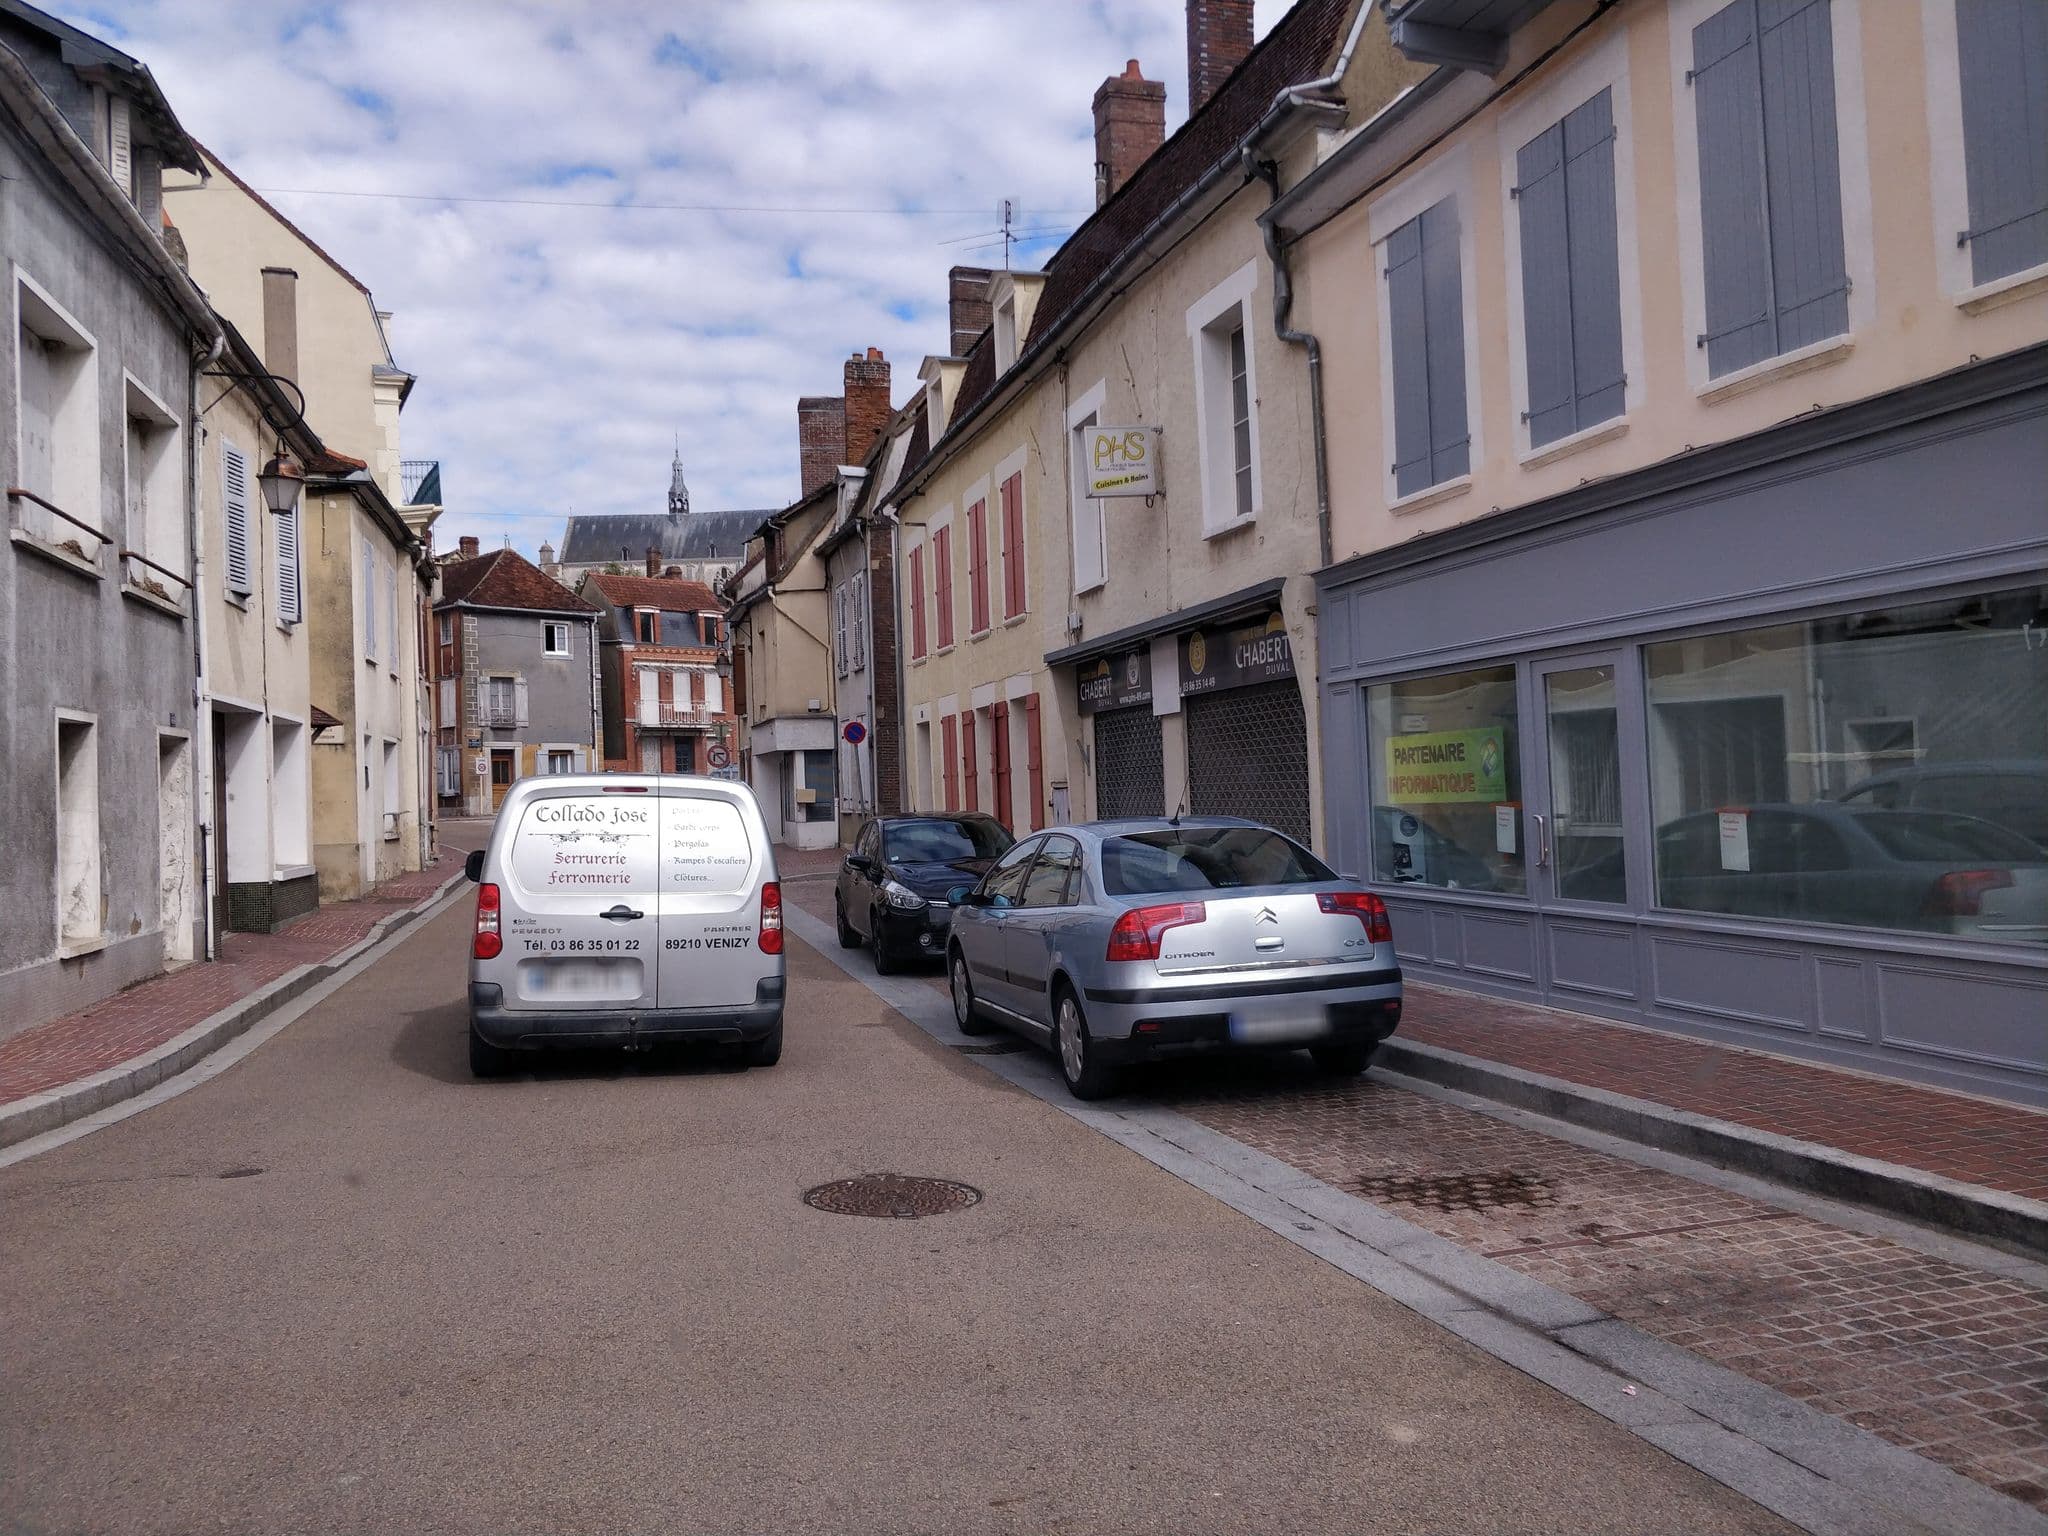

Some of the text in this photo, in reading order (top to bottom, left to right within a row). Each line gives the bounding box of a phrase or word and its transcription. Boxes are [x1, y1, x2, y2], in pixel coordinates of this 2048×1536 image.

[1095, 432, 1145, 467] PHS
[1096, 479, 1123, 489] Cuisines
[1236, 636, 1289, 668] CHABERT
[1266, 663, 1290, 675] DUVAL
[1080, 677, 1112, 701] CHABERT
[1394, 742, 1466, 766] PARTENAIRE
[1389, 772, 1476, 794] INFORMATIQUE
[536, 804, 605, 822] Collado
[554, 851, 627, 865] Serrurerie
[673, 856, 706, 865] Rampes
[548, 870, 631, 884] Ferronnerie
[704, 925, 752, 933] PARTNER
[523, 940, 640, 951] Tél. 03 86 35 01 22
[665, 937, 750, 949] 89210 VENIZY
